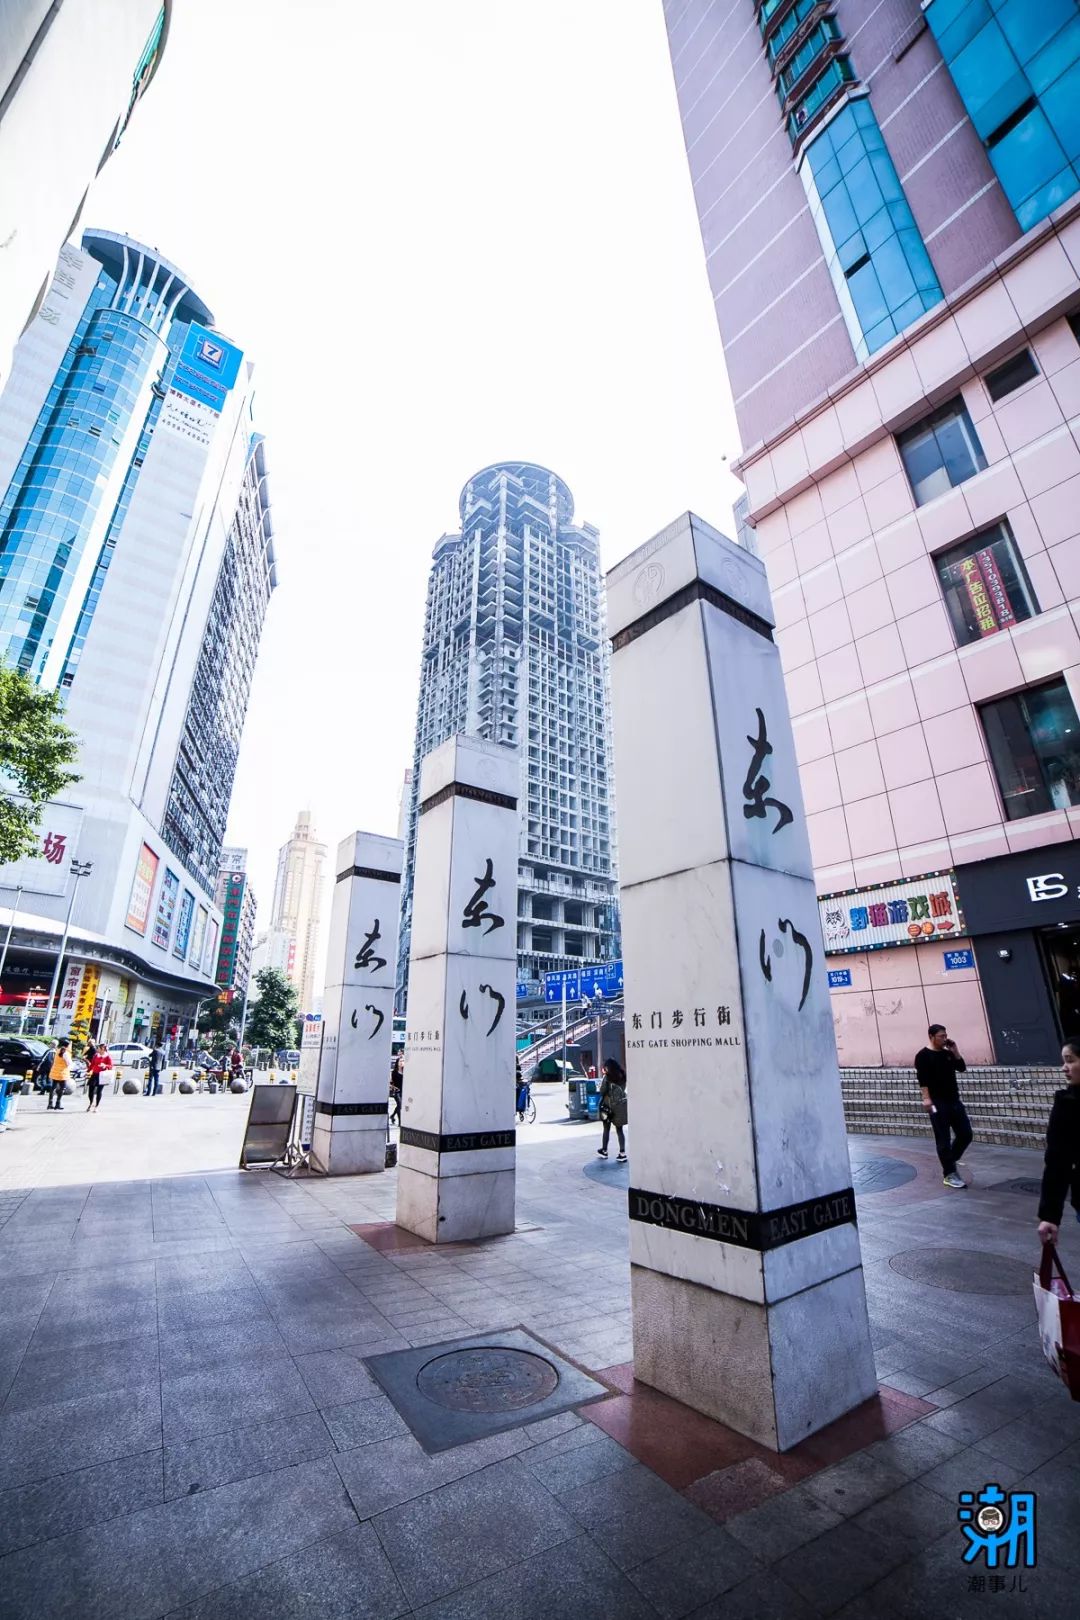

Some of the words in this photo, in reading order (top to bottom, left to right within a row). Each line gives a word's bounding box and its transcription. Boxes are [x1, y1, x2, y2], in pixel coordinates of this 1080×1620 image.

[849, 890, 953, 932] 野猫游戏城
[631, 1005, 731, 1030] 东门步行街
[627, 1040, 645, 1049] EAST
[648, 1039, 669, 1048] GATE
[671, 1037, 713, 1048] SHOPPING
[715, 1037, 741, 1047] MALL
[447, 1136, 477, 1149] EAST
[480, 1133, 512, 1146] GATE
[636, 1196, 750, 1242] DONGMEN
[768, 1209, 808, 1242] EAST
[812, 1195, 852, 1226] GATE
